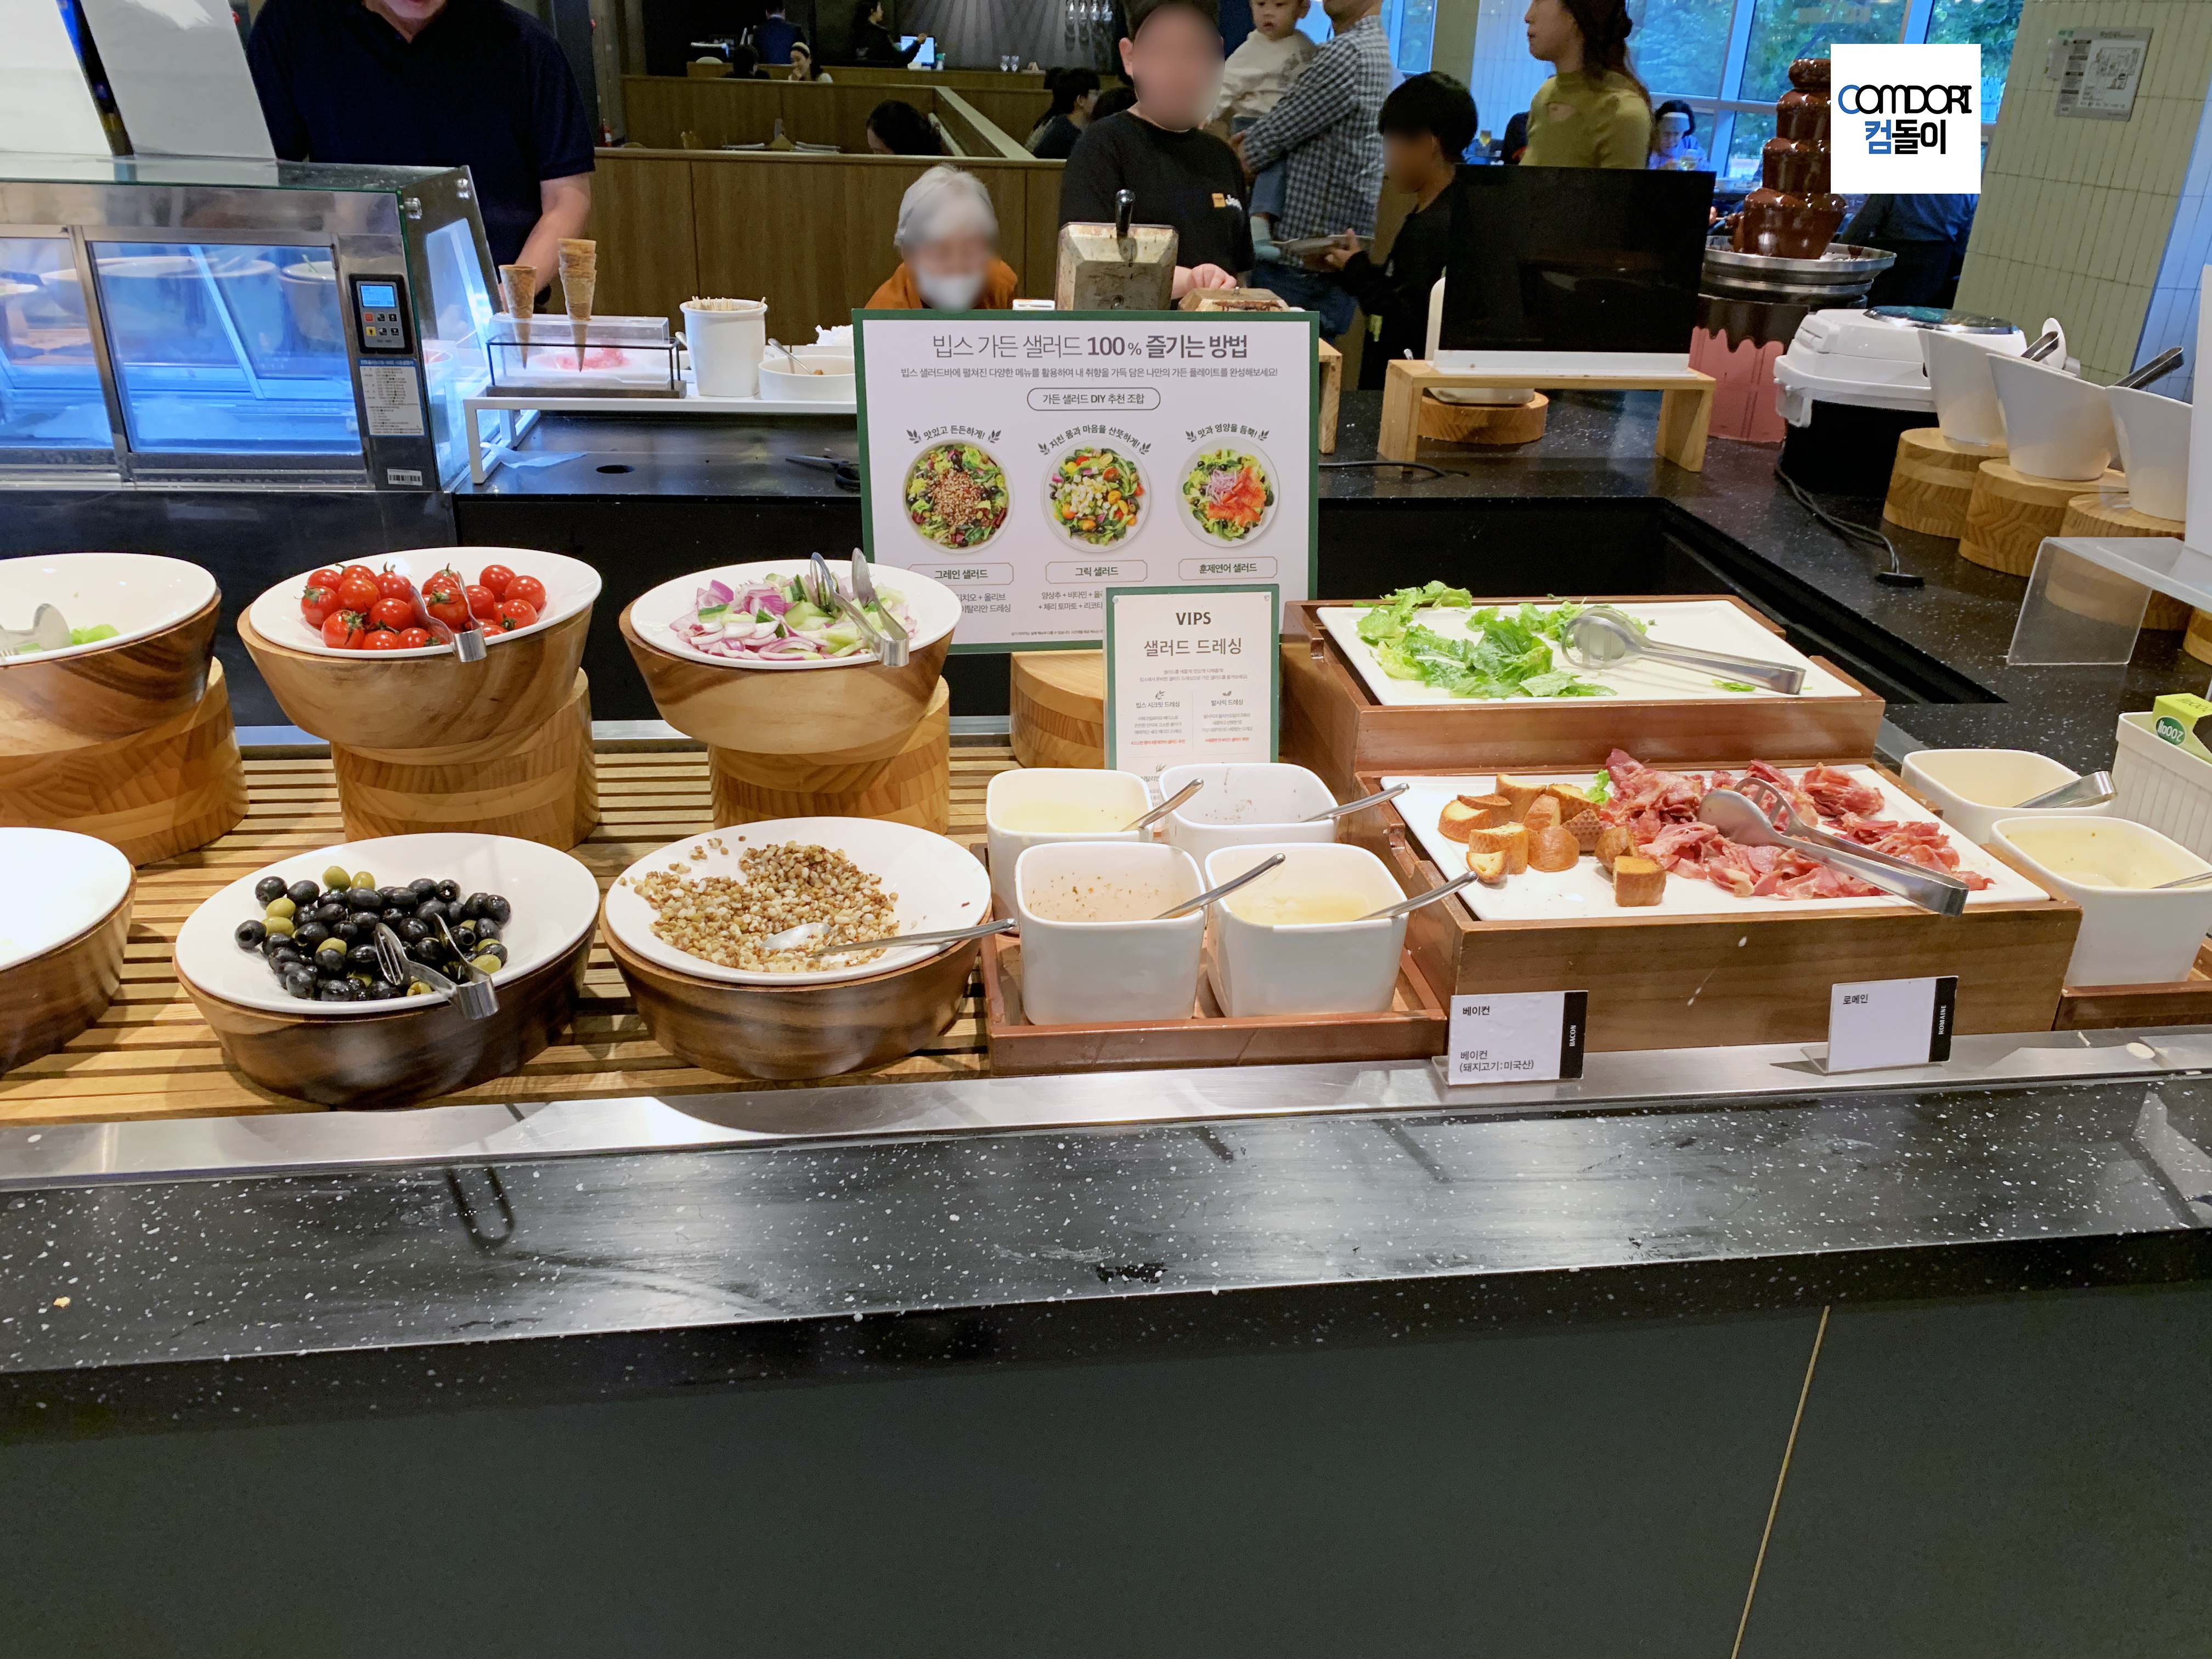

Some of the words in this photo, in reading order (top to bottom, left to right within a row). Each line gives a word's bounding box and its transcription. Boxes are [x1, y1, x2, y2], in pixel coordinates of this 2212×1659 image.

[933, 335, 974, 358] 빕스
[978, 335, 1018, 358] 가든
[1023, 335, 1082, 358] 샐러드
[1146, 335, 1205, 358] 즐기는
[1209, 335, 1247, 358] 방법
[901, 368, 918, 377] 빕스
[920, 368, 961, 377] 샐러드바에
[963, 368, 987, 377] 펼쳐진
[989, 368, 1013, 377] 다양한
[1015, 368, 1040, 377] 메뉴를
[1042, 368, 1074, 377] 활용하여
[1076, 368, 1084, 377] 내
[1085, 368, 1109, 377] 취향을
[1111, 368, 1127, 377] 가득
[1129, 368, 1144, 377] 담은
[1147, 368, 1170, 377] 나만의
[1172, 368, 1188, 377] 가든
[1189, 368, 1228, 377] 플레이트를
[1229, 368, 1278, 377] 완성해보세요!
[1043, 394, 1060, 404] 가든
[1063, 394, 1089, 404] 샐러드
[1091, 394, 1106, 403] DIY
[1108, 393, 1125, 404] 추천
[1127, 393, 1144, 404] 조합
[923, 426, 948, 440] 맛있고
[950, 425, 985, 439] 든든하게!
[1197, 426, 1213, 438] 맛과
[1215, 423, 1238, 432] 영양을
[1240, 425, 1257, 438] 듬뿍!
[1049, 435, 1065, 449] 지친
[1065, 426, 1081, 439] 몸과
[1082, 424, 1107, 434] 마음을
[1108, 426, 1141, 448] 산뜻하게!
[934, 569, 960, 579] 그레인
[962, 569, 988, 579] 샐러드
[1075, 567, 1092, 577] 그릭
[1094, 567, 1119, 577] 샐러드
[1199, 563, 1231, 574] 훈제연어
[1233, 563, 1257, 573] 샐러드
[984, 593, 1006, 601] 올리브
[989, 604, 1011, 612] 드레싱
[1176, 612, 1211, 625] VIPS
[1144, 640, 1190, 657] 샐러드
[1196, 637, 1242, 655] 드레싱
[2157, 720, 2184, 742] 200매
[1842, 994, 1869, 1005] 로메인
[1463, 1006, 1490, 1015] 베이컨
[1938, 1005, 1946, 1035] ROMAINE
[1460, 1050, 1487, 1060] 베이컨
[1459, 1059, 1534, 1073] (돼지고기:미국산)
